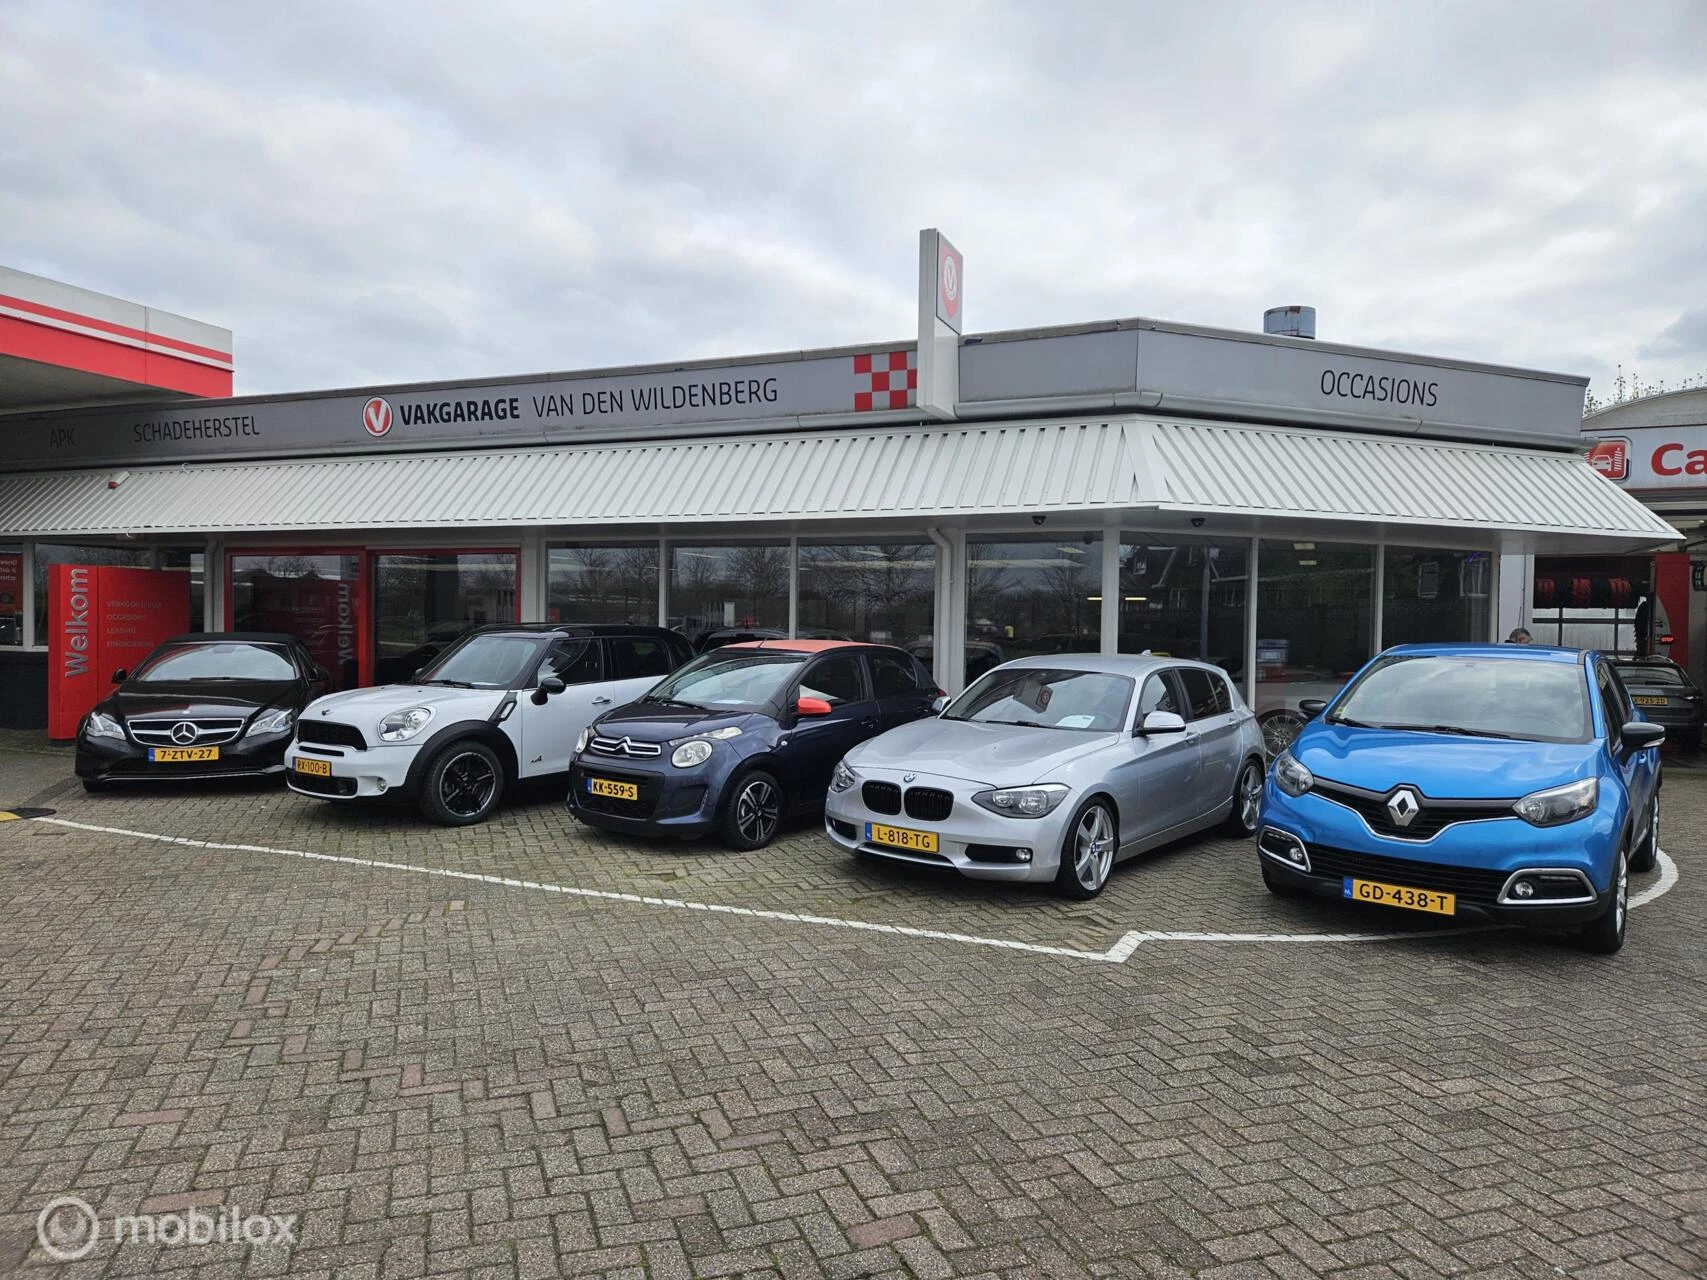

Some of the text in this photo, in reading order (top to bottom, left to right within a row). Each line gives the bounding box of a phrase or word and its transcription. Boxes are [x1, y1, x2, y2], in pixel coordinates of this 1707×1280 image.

[400, 398, 520, 426] VAKGARAGE
[533, 393, 574, 418] VAN
[582, 390, 624, 415] DEN
[630, 377, 778, 412] WILDENBERG
[1320, 369, 1439, 407] OCCASIONS
[49, 428, 77, 448] APK
[134, 415, 261, 443] SCHADEHERSTEL
[1651, 443, 1707, 477] Ca
[65, 568, 88, 678] Welkom
[160, 749, 213, 760] 7-ZTV-27
[592, 781, 634, 798] KK-559-S
[877, 827, 931, 848] L-818-TG
[1359, 883, 1448, 911] GD-438-T
